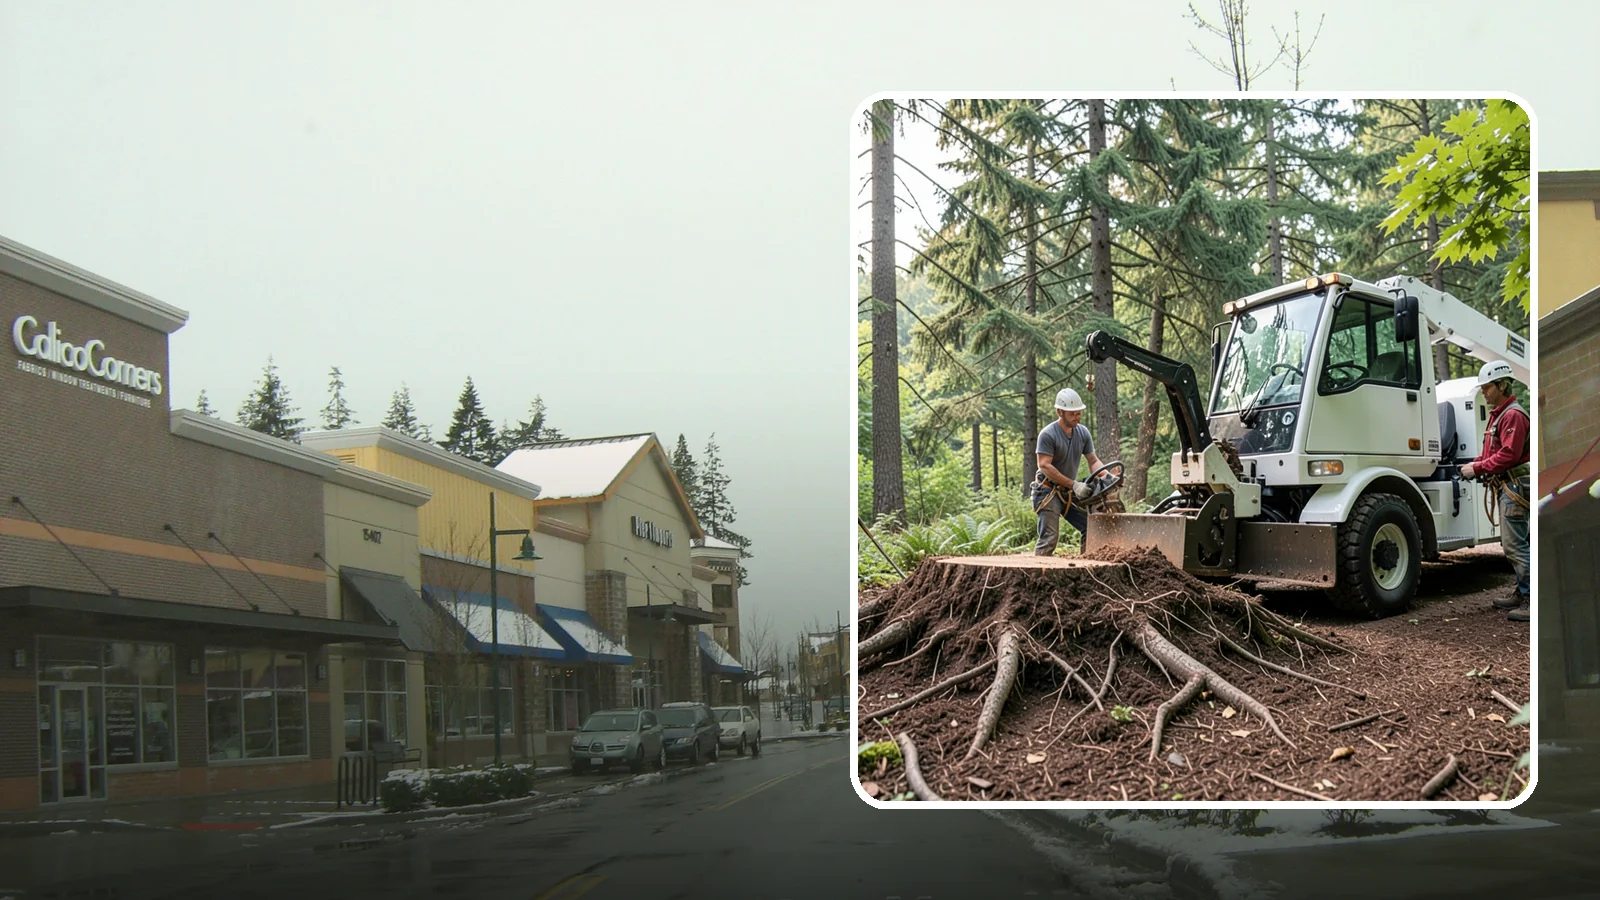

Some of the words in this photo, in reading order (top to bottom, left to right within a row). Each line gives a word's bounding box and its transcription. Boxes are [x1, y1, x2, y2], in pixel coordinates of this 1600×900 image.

[17, 360, 47, 378] FABRICS
[51, 370, 78, 387] WINDOW
[78, 378, 116, 399] TREATMENTS
[120, 391, 151, 409] FURNITURE
